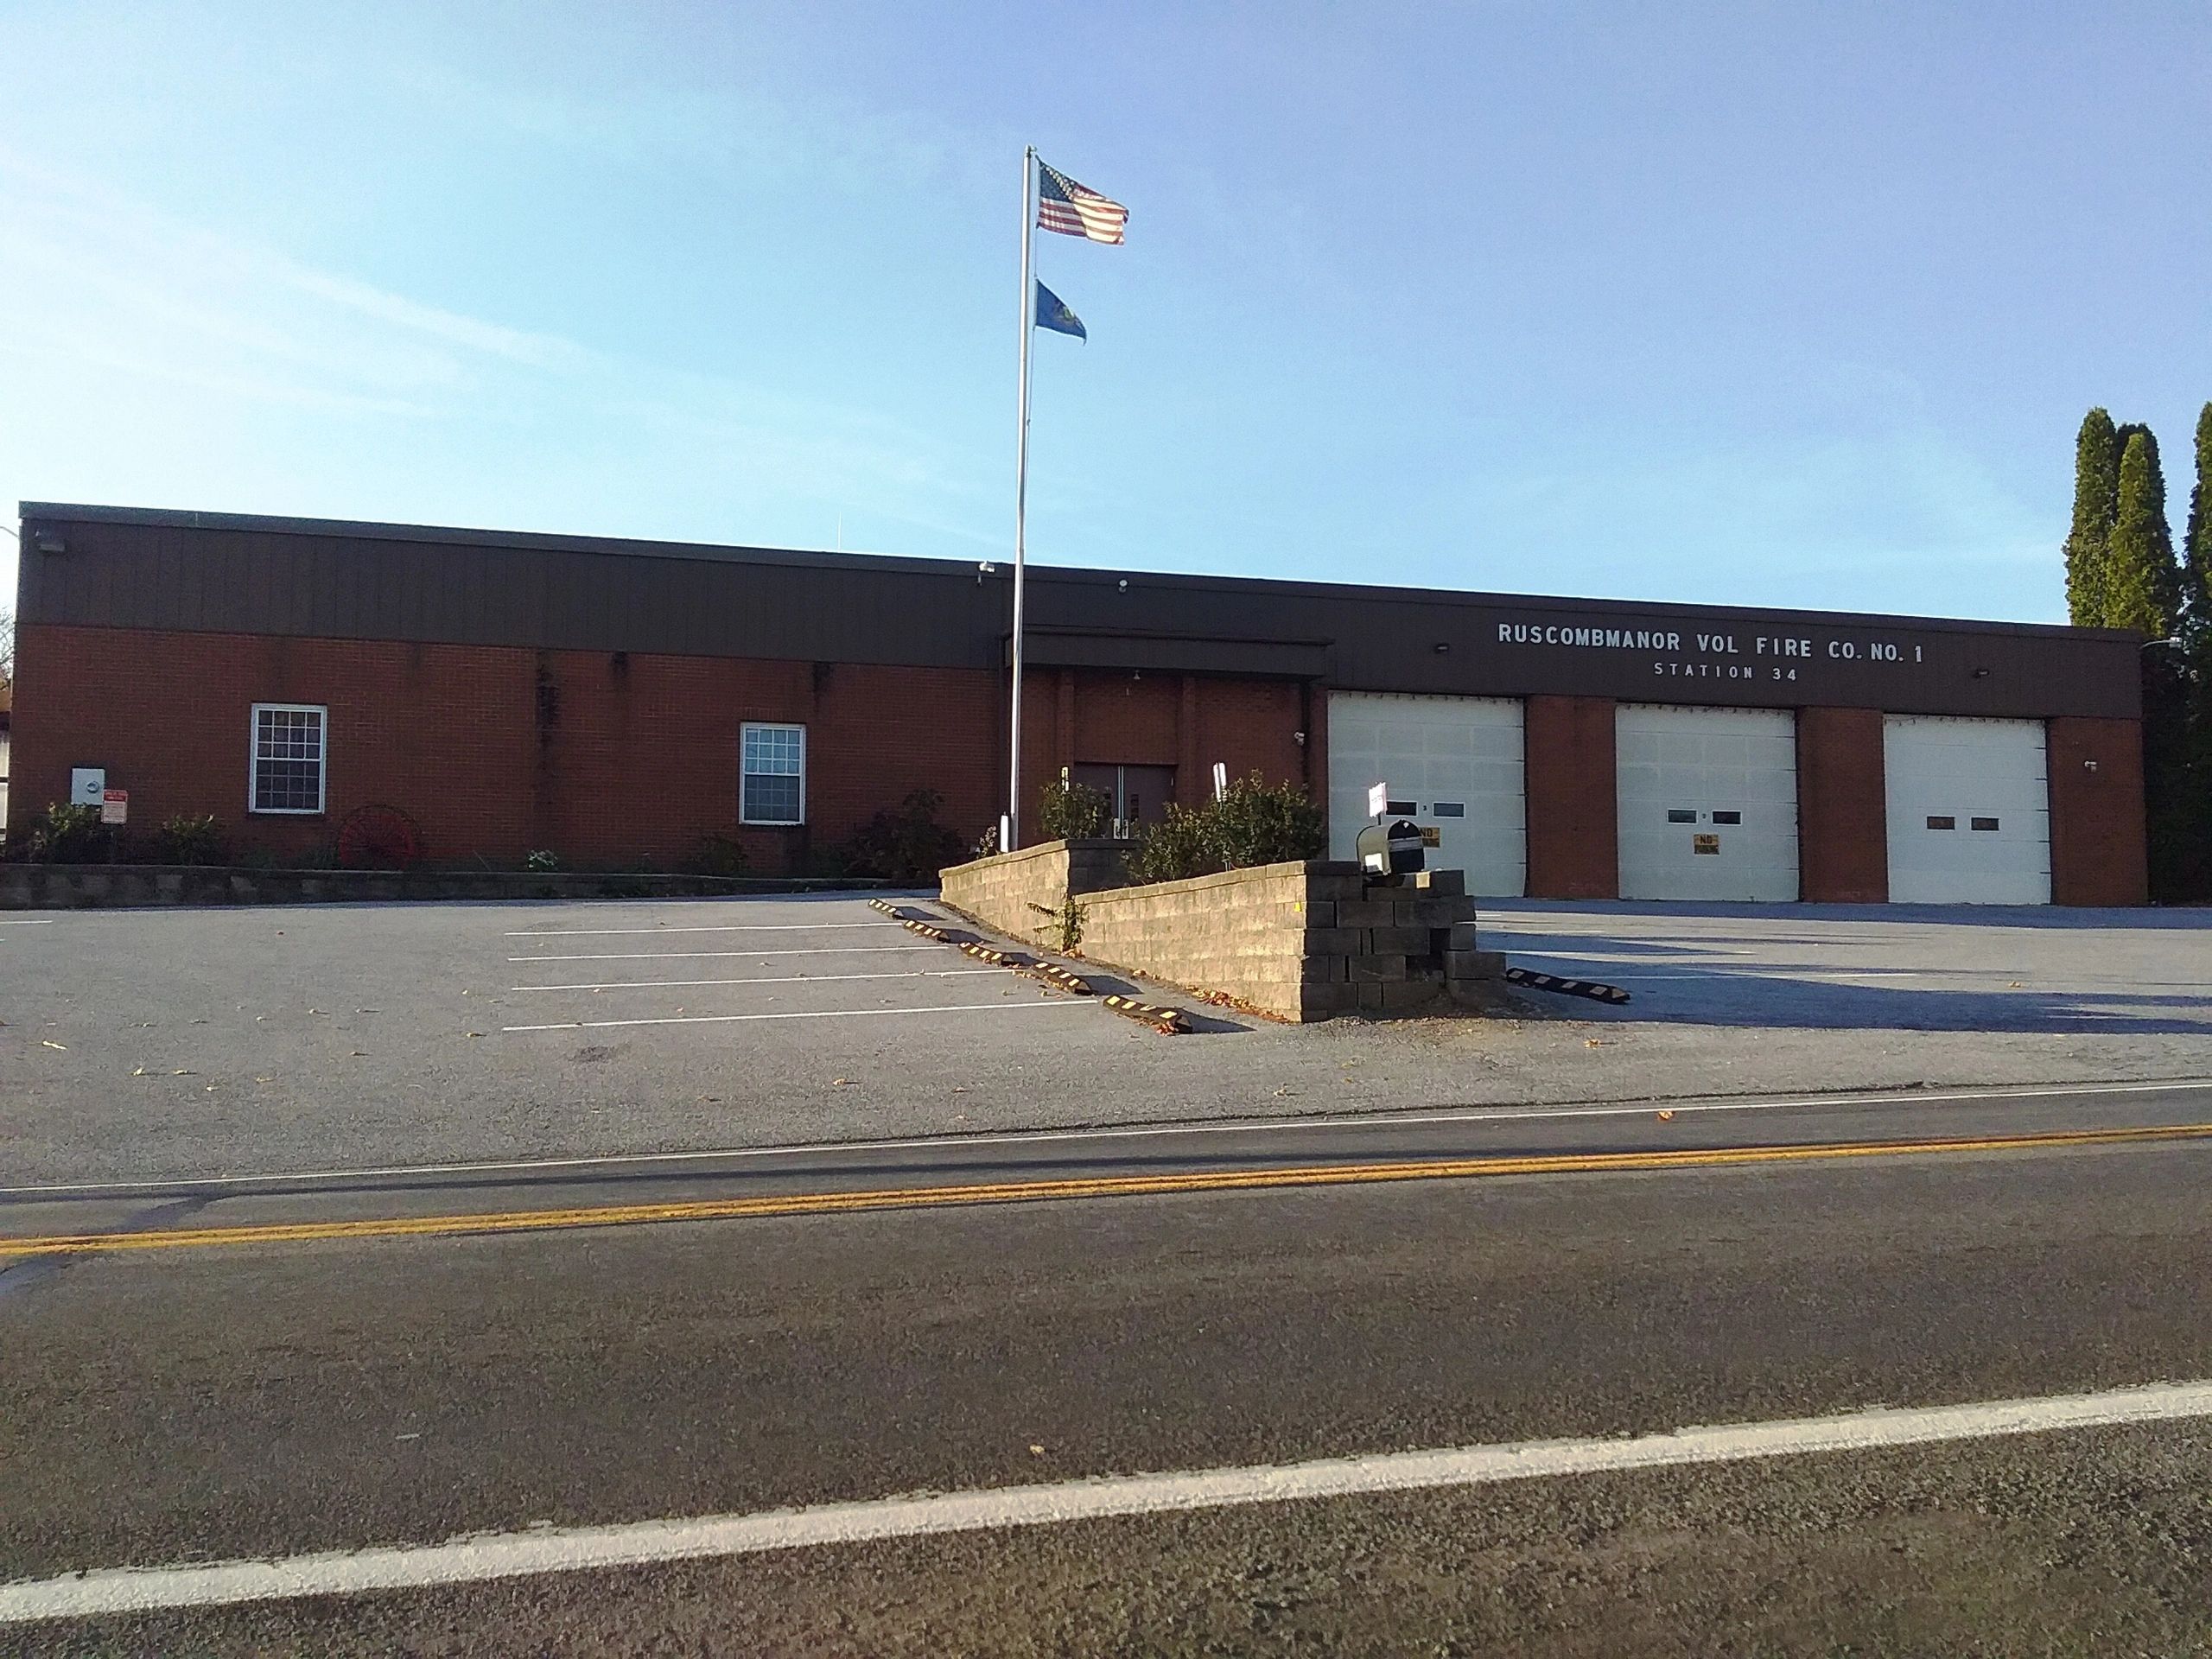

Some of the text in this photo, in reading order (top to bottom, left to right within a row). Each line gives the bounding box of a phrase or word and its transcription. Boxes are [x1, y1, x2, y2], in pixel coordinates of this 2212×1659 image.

[1498, 624, 1923, 663] RUSCOMBMANOR VOL FIRE CO. NO. 1
[1654, 663, 1796, 680] STATION 34
